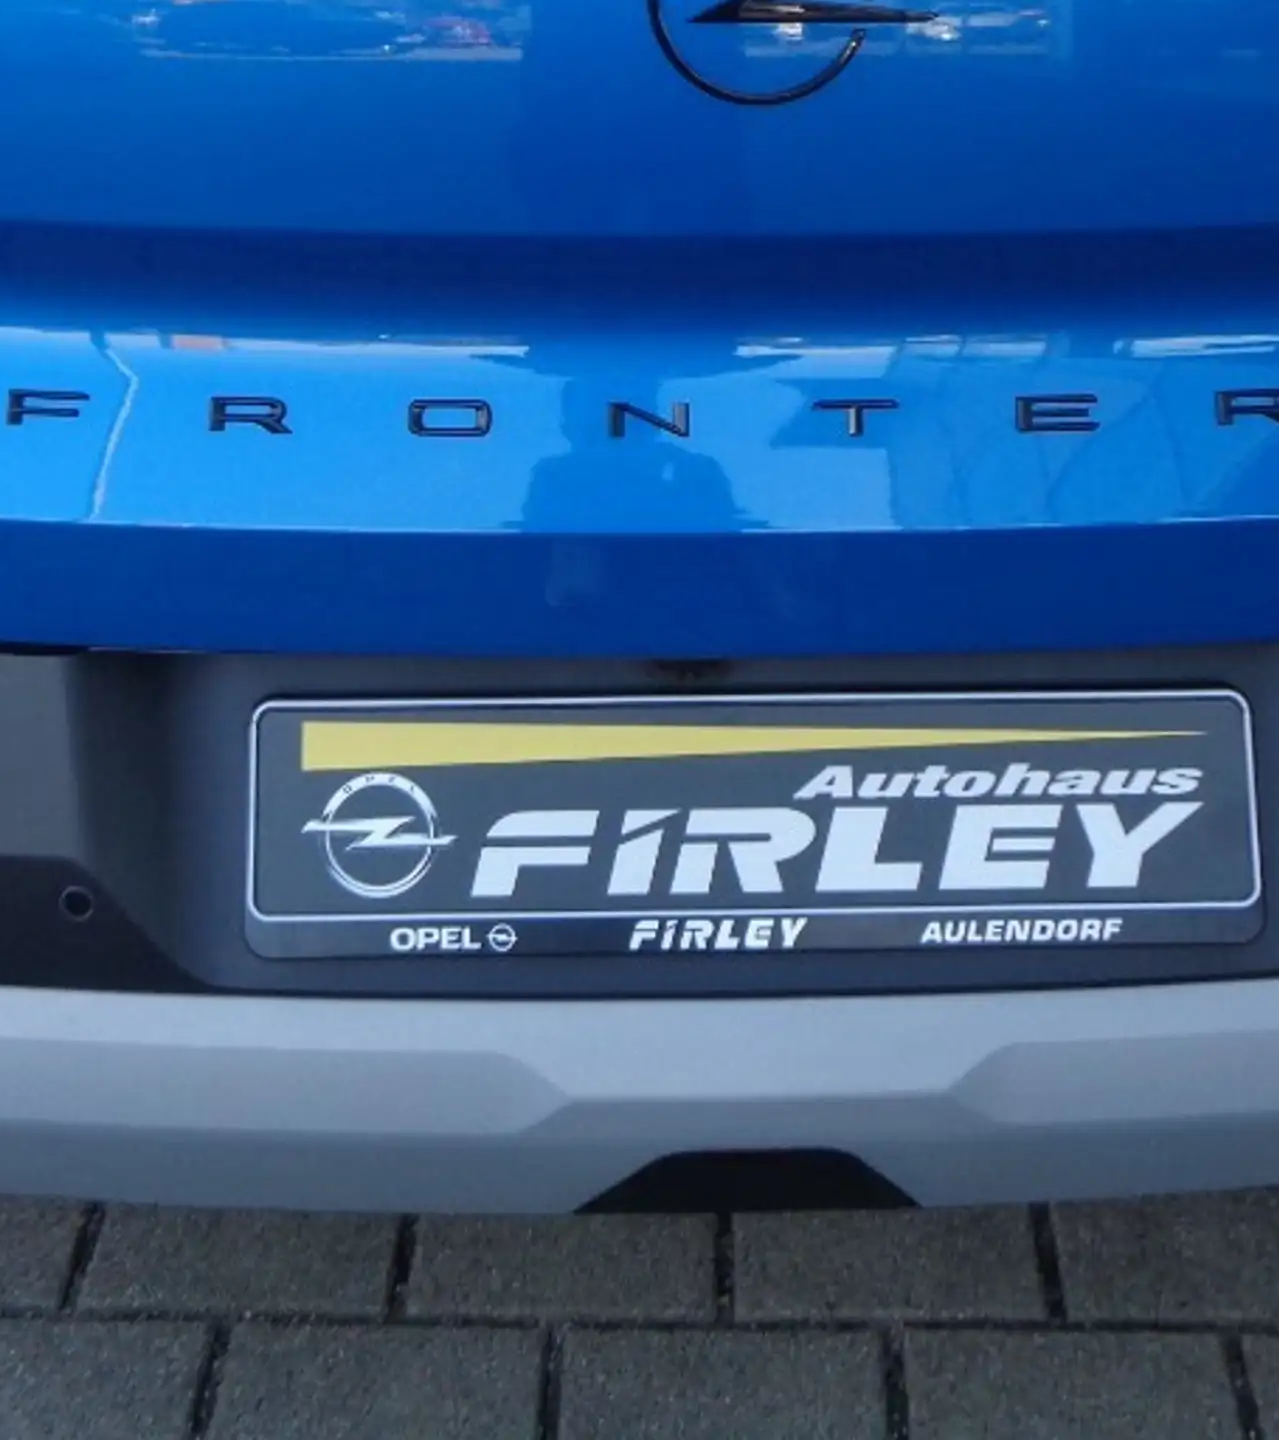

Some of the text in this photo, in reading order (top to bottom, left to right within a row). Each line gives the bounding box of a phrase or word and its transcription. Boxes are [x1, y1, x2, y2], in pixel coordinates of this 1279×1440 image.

[792, 762, 1203, 800] Autohaus
[469, 800, 1205, 897] FIRLEY
[389, 925, 483, 952] OPEL
[920, 917, 1124, 945] AULENDORF
